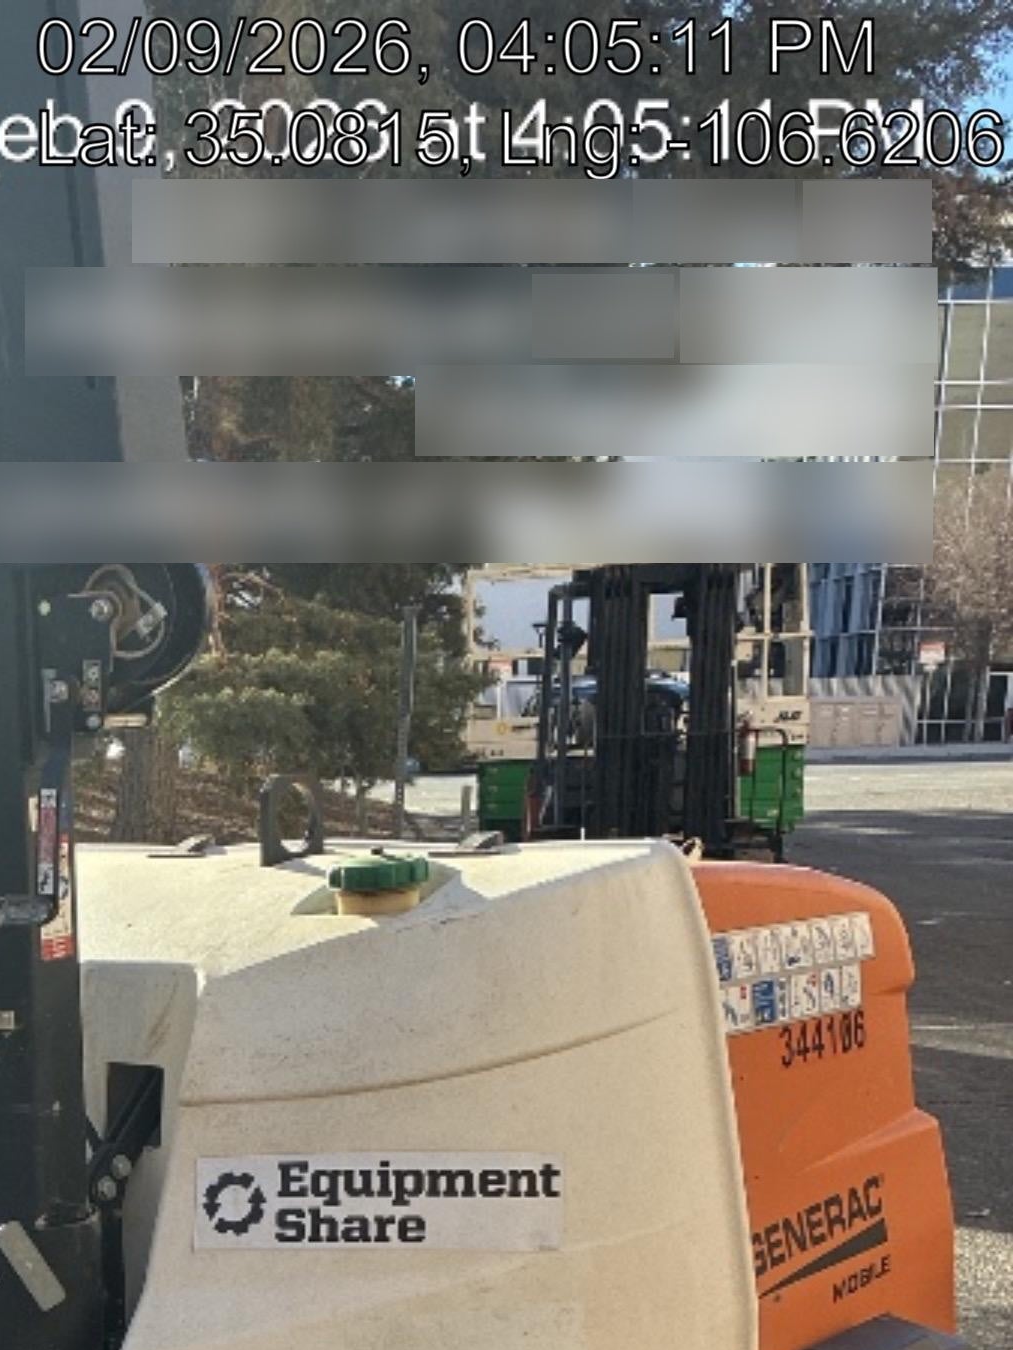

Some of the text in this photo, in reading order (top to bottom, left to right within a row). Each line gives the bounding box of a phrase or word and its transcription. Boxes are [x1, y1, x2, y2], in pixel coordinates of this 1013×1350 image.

[276, 1160, 561, 1206] Equipment
[274, 1208, 426, 1244] Share
[751, 1174, 884, 1279] GENERAC
[832, 1254, 891, 1303] MOBILE
